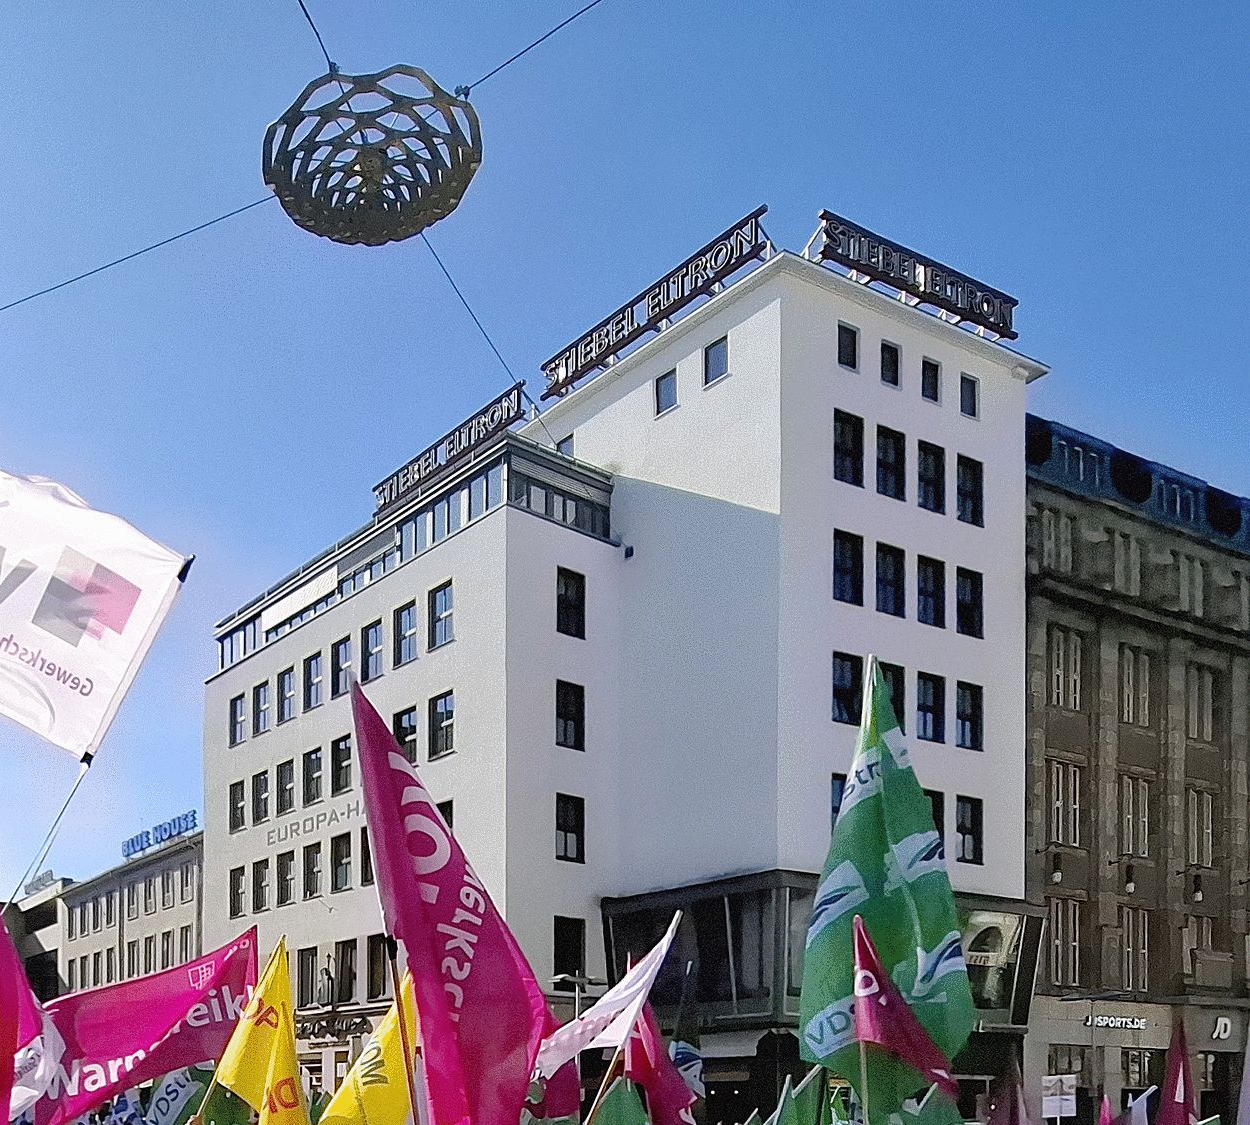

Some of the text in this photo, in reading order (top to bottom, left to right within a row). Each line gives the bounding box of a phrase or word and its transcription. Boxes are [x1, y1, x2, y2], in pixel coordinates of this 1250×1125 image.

[544, 217, 757, 388] STIEBEL ELTRON
[823, 220, 1013, 329] STIEBEL ELTRON
[376, 389, 518, 505] STIEBEL ELTRON
[122, 810, 198, 858] BLUE HOUSE
[1211, 1017, 1232, 1040] JD
